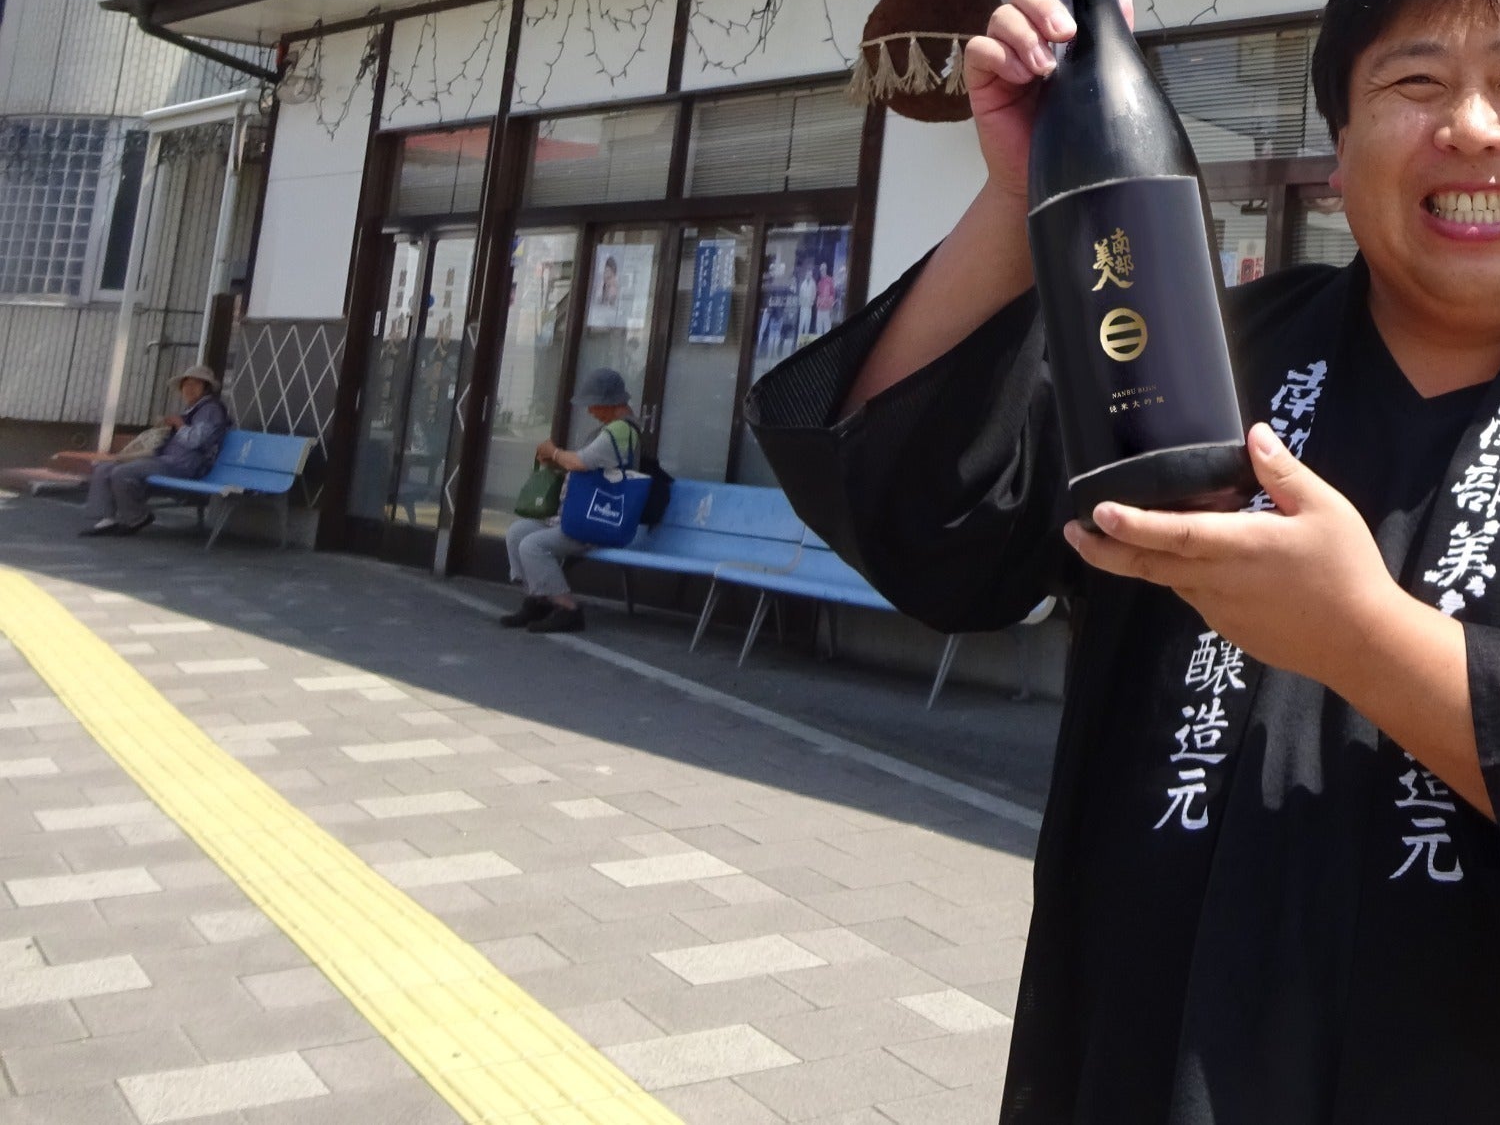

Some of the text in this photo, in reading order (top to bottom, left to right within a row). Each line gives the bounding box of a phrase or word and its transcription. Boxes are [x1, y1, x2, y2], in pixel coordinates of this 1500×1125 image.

[1091, 239, 1135, 291] 美人
[1111, 227, 1135, 277] 南部
[1112, 388, 1136, 399] NANBU
